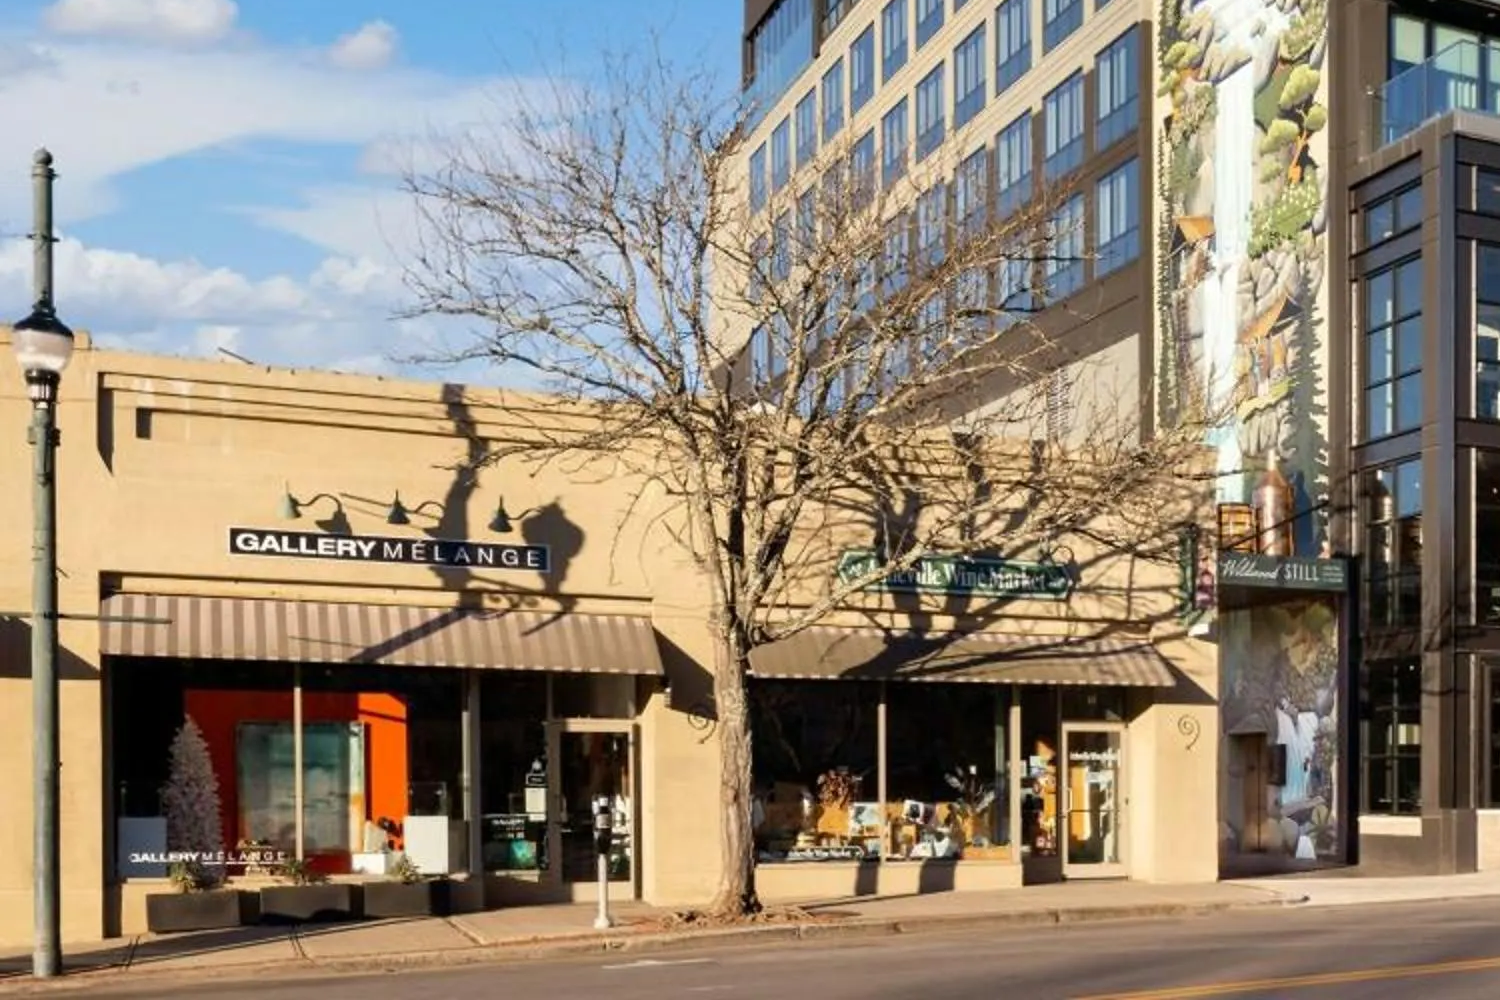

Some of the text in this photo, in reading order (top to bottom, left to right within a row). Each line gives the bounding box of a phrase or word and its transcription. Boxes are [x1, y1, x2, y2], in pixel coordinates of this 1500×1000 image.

[235, 532, 541, 567] GALLERY MÉLANGE
[943, 563, 987, 587] Wine
[989, 567, 1046, 591] Market
[1284, 563, 1320, 582] STILL
